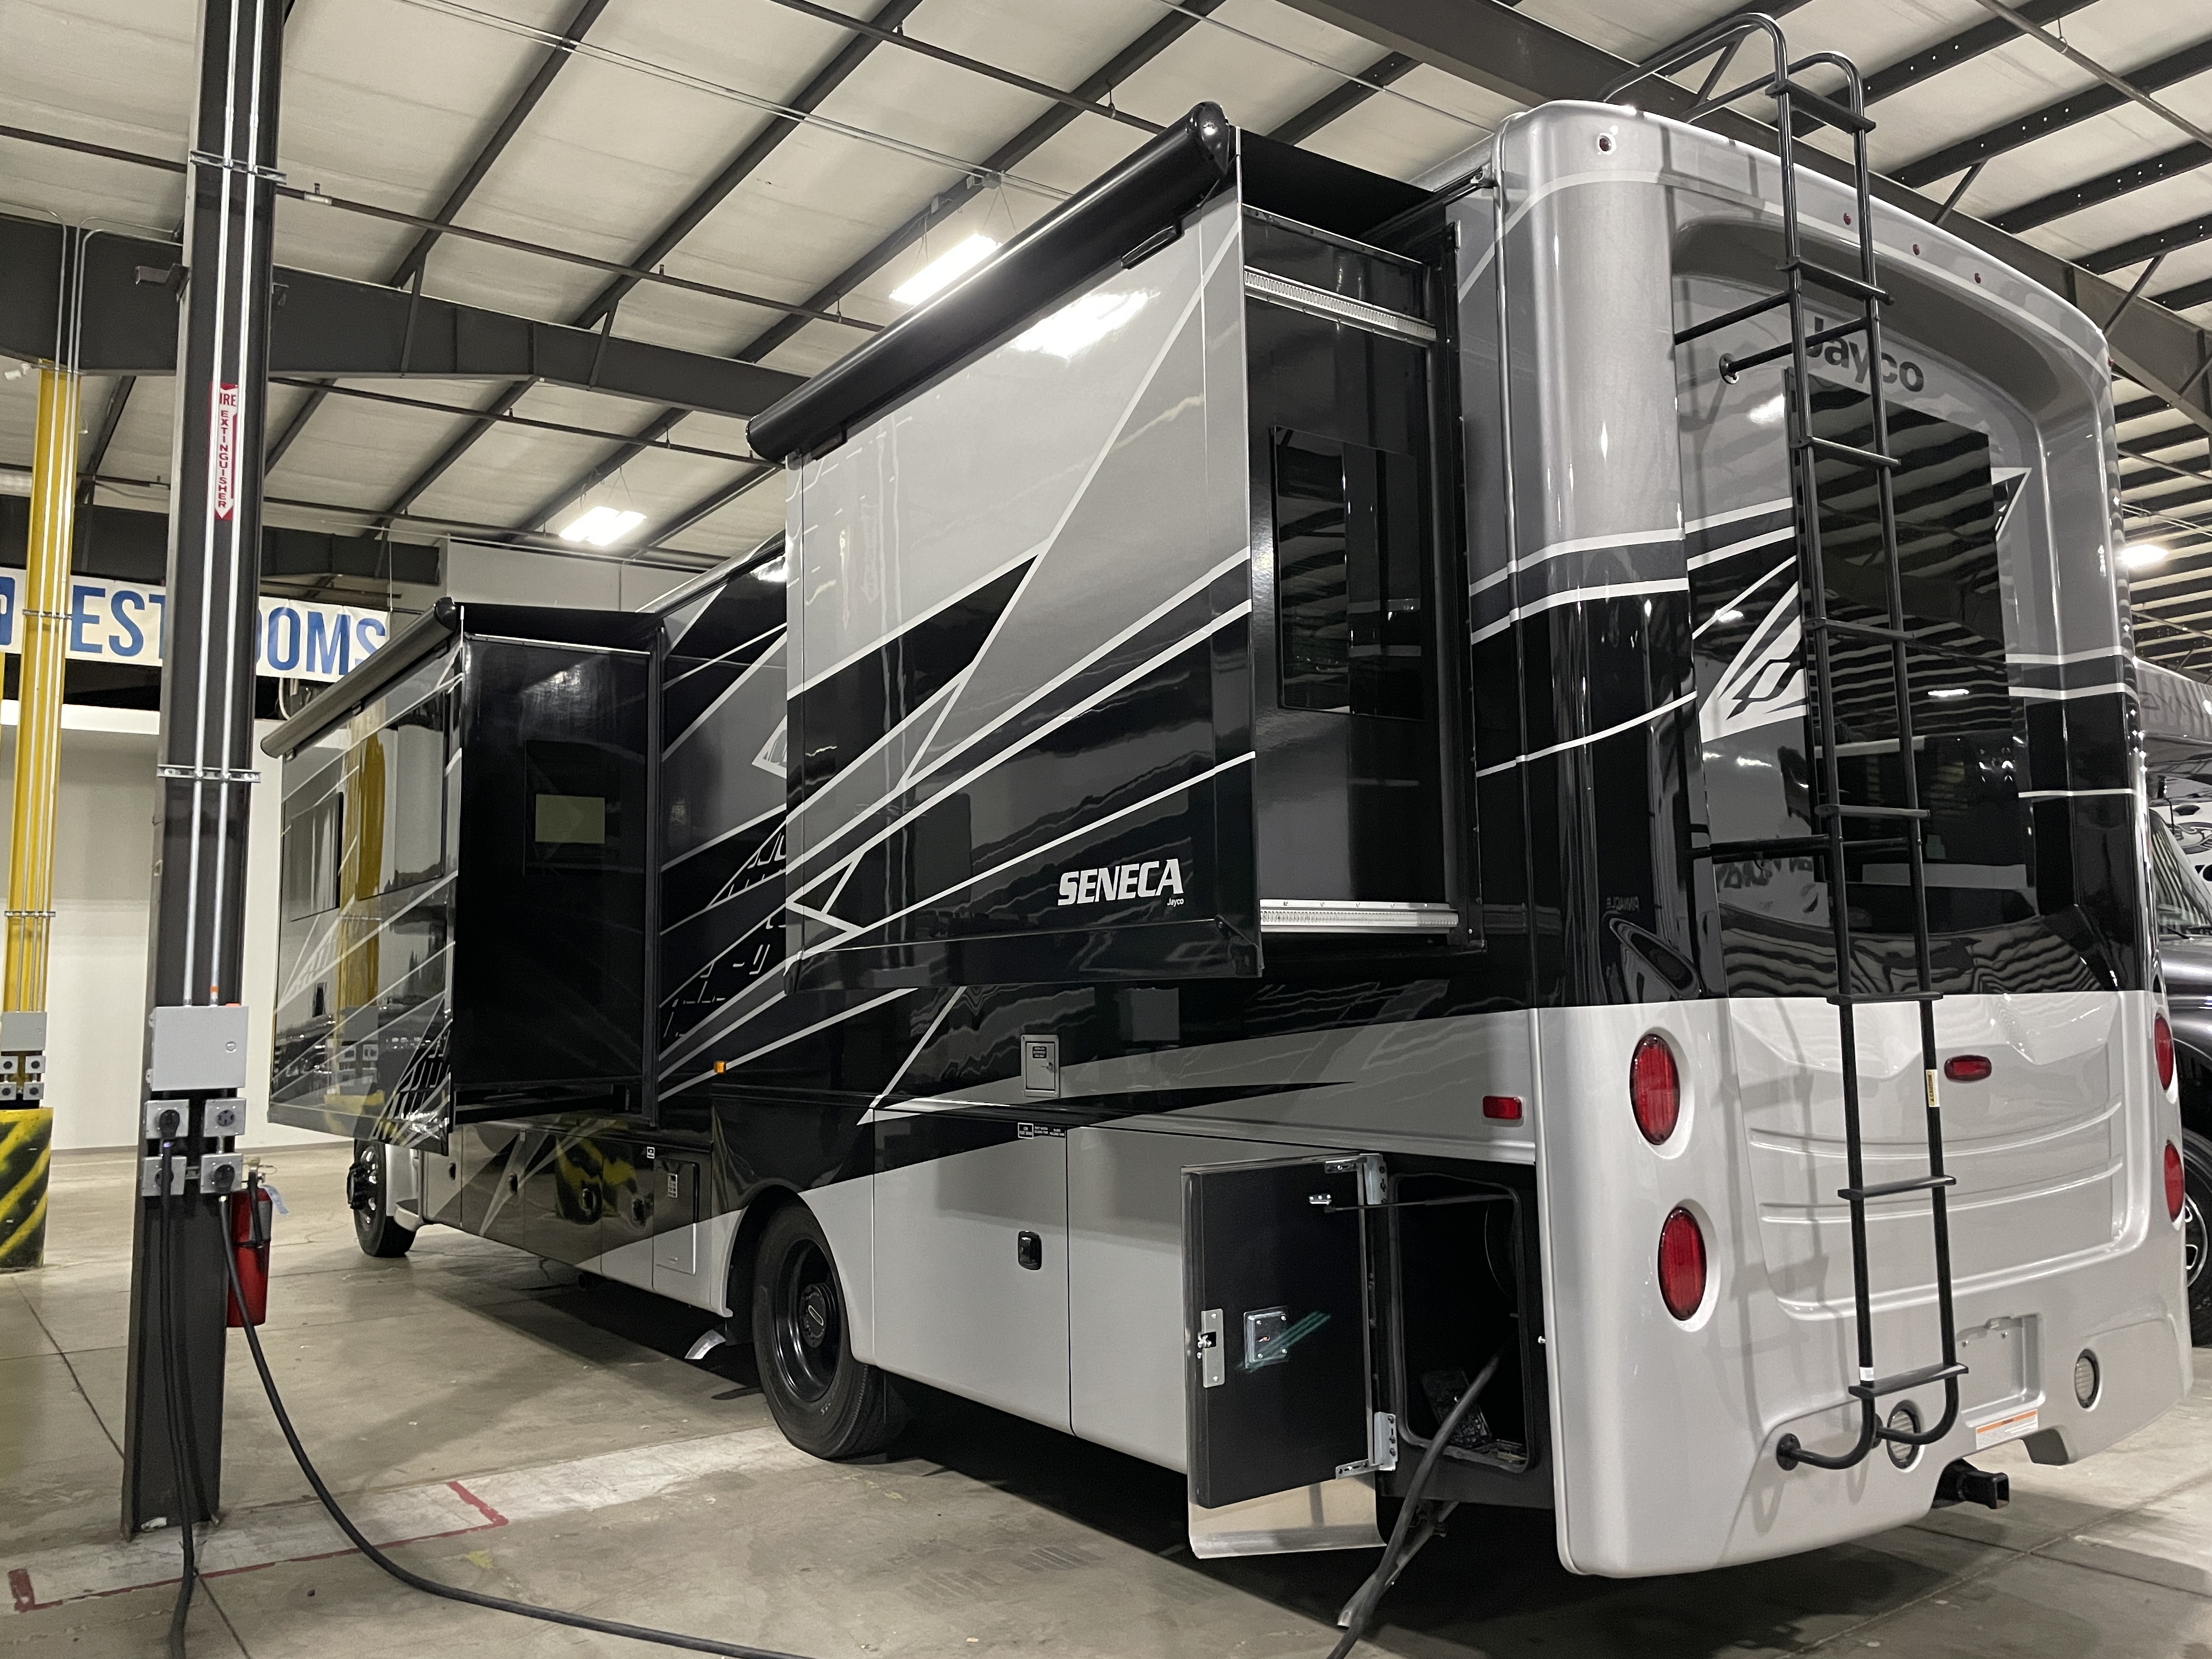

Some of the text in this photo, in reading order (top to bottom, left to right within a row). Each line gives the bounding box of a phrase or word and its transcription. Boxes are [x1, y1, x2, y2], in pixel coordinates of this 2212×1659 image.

[219, 393, 237, 407] IRE
[217, 410, 229, 509] EXTINGUISHER
[1058, 859, 1184, 906] SENECA
[1167, 897, 1184, 907] Jayco
